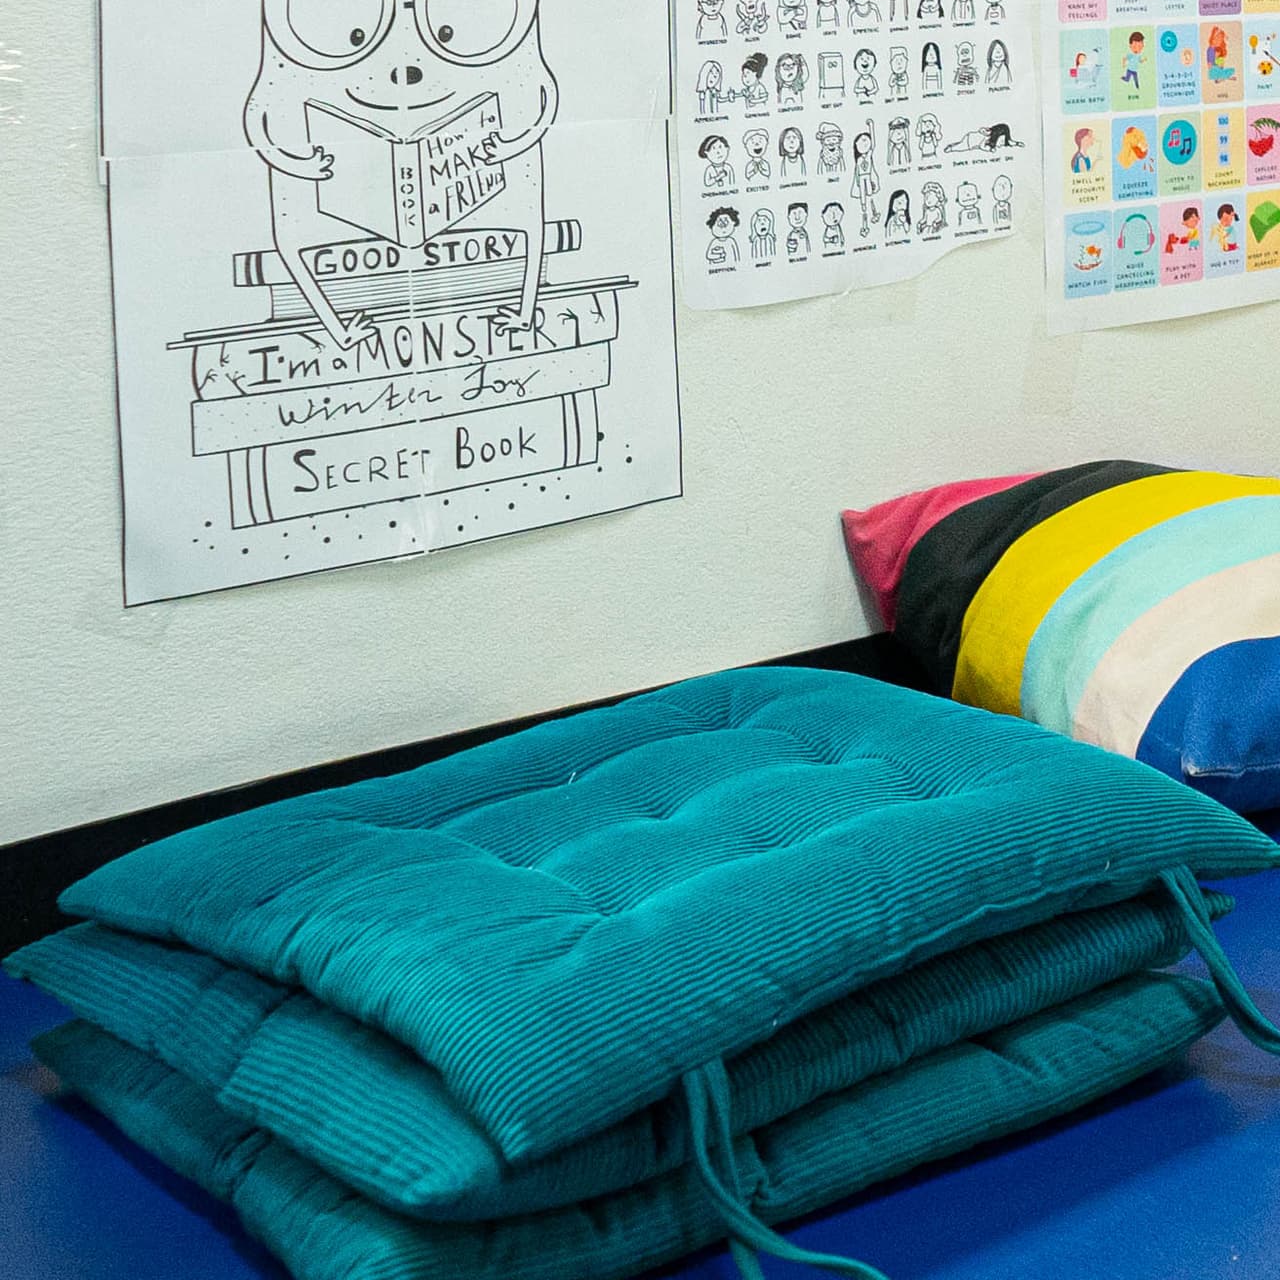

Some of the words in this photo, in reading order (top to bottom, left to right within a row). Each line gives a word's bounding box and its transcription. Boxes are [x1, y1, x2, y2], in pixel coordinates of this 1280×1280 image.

[313, 246, 401, 277] GOOD
[423, 232, 518, 266] STORY
[332, 357, 348, 371] a
[356, 307, 558, 373] MONSTER
[278, 381, 444, 427] Winter
[293, 448, 431, 493] SECRET
